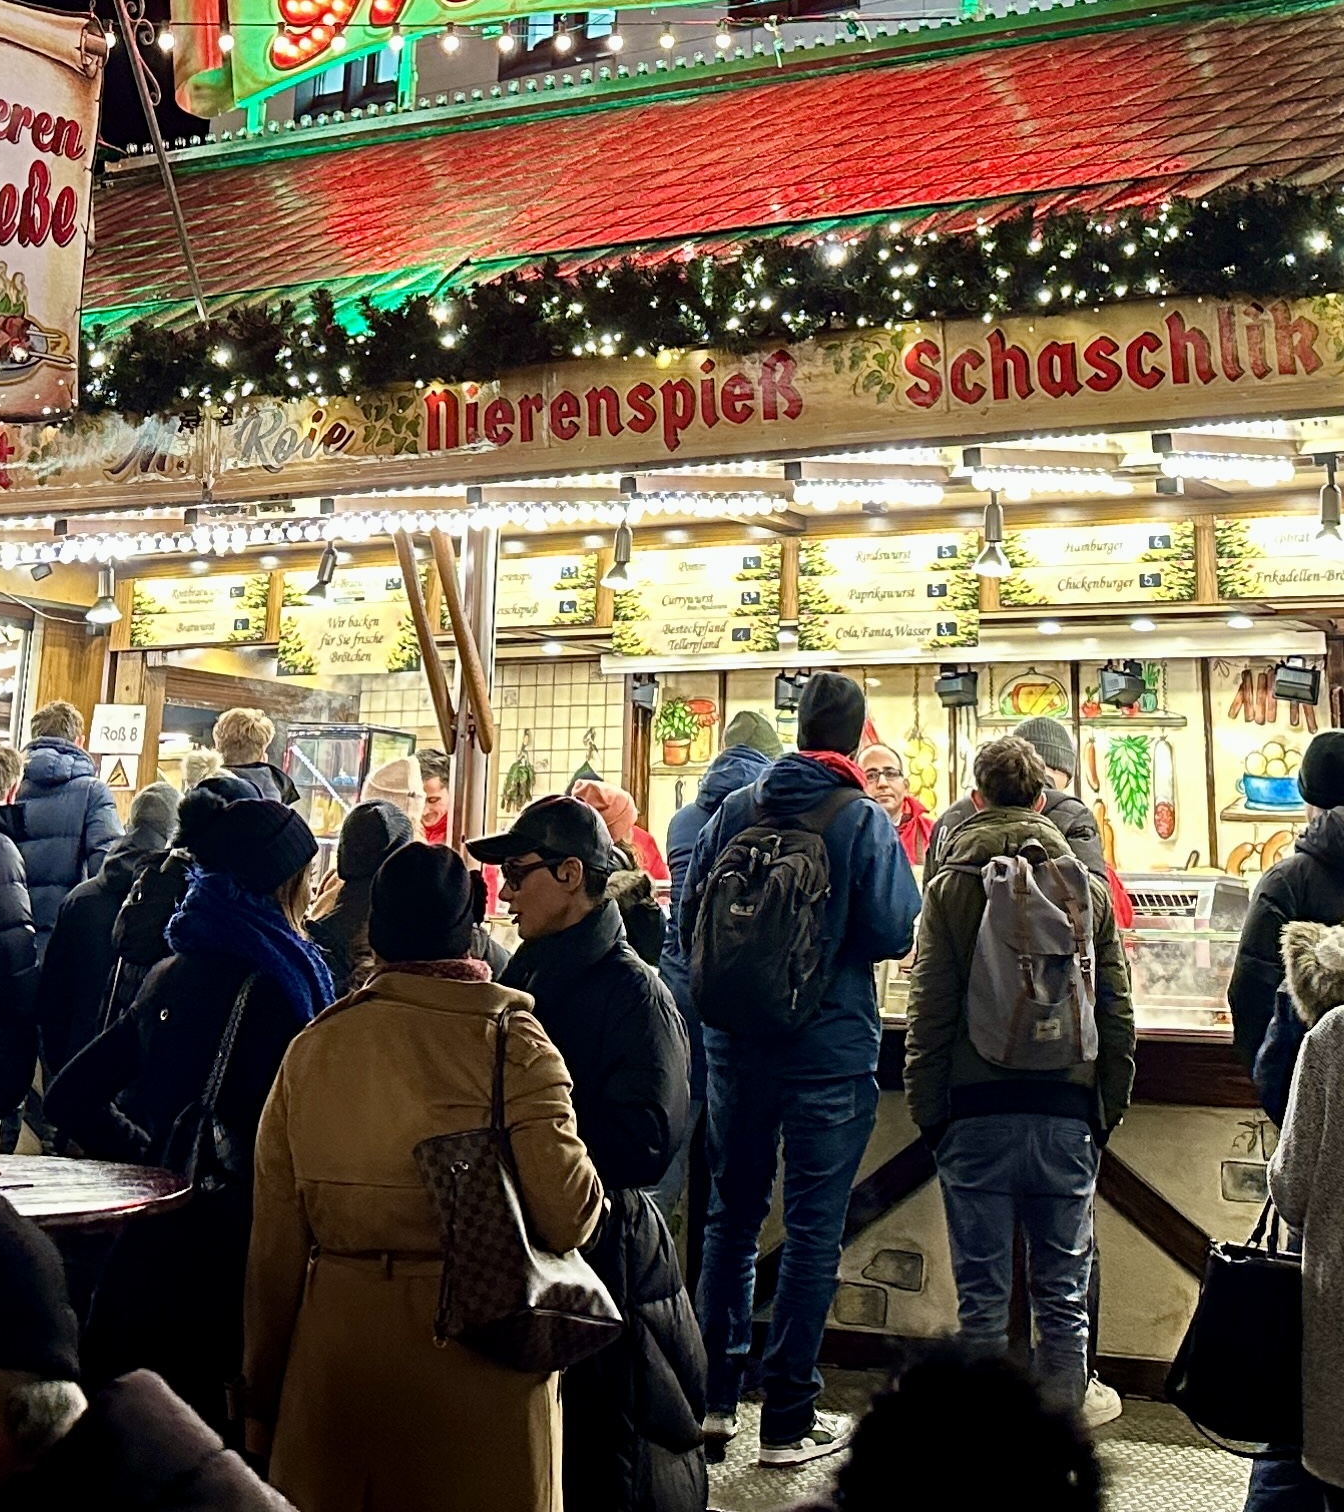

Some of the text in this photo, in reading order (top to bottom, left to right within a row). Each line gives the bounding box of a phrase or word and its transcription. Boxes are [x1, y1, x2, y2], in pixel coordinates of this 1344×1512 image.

[902, 302, 1325, 412] Schaschlik
[422, 349, 805, 452] Nierenspieß
[1065, 539, 1123, 555] Hamburger
[1057, 576, 1135, 592] Chickenburger
[662, 594, 714, 607] Currywurst
[848, 586, 916, 604] Paprikawurst
[328, 614, 379, 630] Wir backen
[662, 620, 729, 636] Besteckpfand
[318, 630, 384, 650] für Sie frische
[835, 624, 932, 640] Cola, Fanta, Wasser
[668, 636, 723, 653] Tellerpfand
[330, 649, 372, 663] Brötchen
[100, 726, 138, 742] Roß 8
